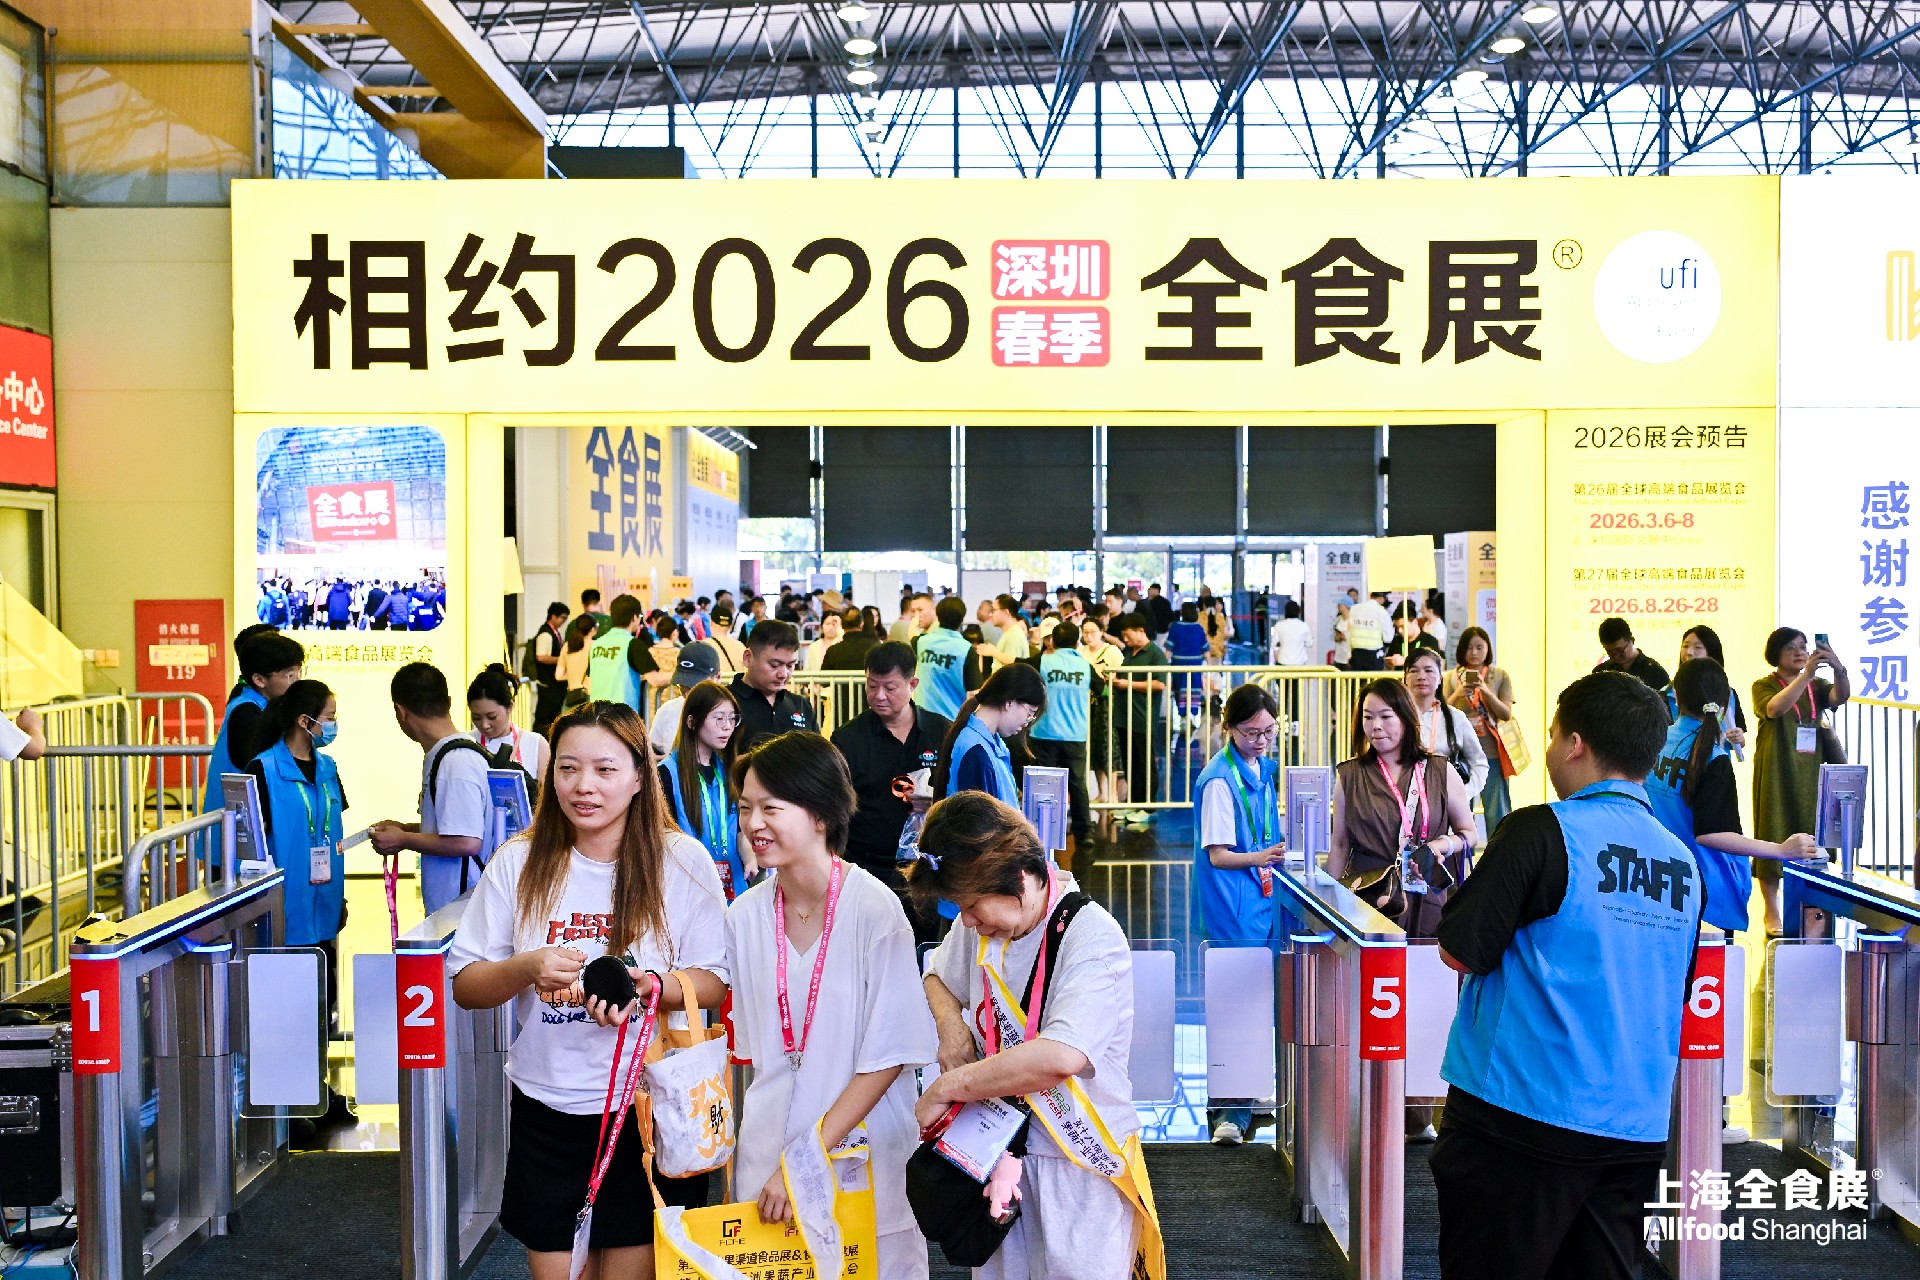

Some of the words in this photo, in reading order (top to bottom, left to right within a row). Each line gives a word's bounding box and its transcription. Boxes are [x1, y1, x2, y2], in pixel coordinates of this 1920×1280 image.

[995, 244, 1101, 297] 深圳
[1660, 258, 1698, 289] ufi
[294, 233, 969, 369] 相约2026
[996, 311, 1102, 363] 春季
[0, 371, 45, 415] 中心
[13, 417, 48, 439] Center
[1575, 425, 1748, 448] 2026展会预告
[313, 489, 391, 516] 全食展
[586, 426, 664, 559] 全食展
[1590, 512, 1695, 529] 2026.3.6-8
[1589, 597, 1719, 614] 2026.8.26-28
[1860, 480, 1910, 702] 感谢参观
[592, 646, 621, 660] STAFF
[921, 650, 957, 670] STAFF
[167, 666, 196, 680] 119
[1047, 670, 1085, 686] STAFF
[1597, 843, 1693, 913] STAFF
[570, 912, 614, 927] BEST
[80, 990, 100, 1031] 1
[404, 985, 435, 1027] 2
[1370, 977, 1401, 1019] 5
[1689, 976, 1721, 1019] 6
[1039, 1090, 1063, 1120] iFresh
